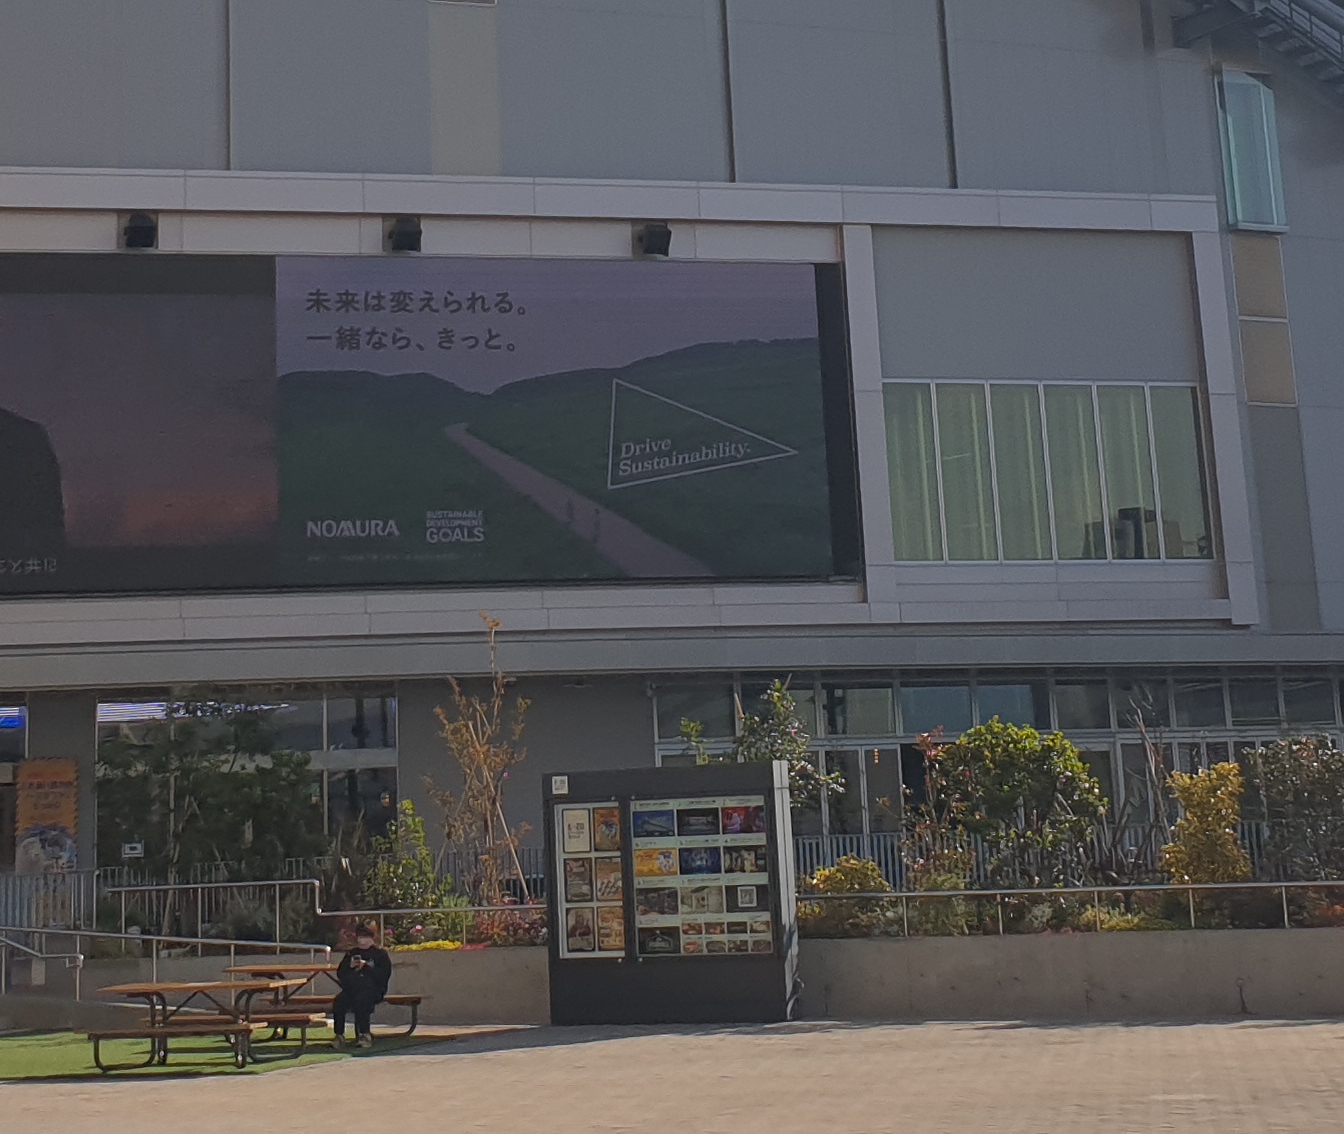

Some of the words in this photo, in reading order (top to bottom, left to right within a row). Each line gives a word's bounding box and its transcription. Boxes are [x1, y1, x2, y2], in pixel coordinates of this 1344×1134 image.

[305, 288, 529, 317] 未来は変えられる。
[305, 325, 517, 352] 一緒なら、きっと。
[619, 438, 672, 459] Drive
[425, 510, 484, 519] SUSTAINABLE
[425, 519, 484, 528] DEVELOPMENT
[306, 519, 400, 538] NOMURA
[425, 527, 485, 543] GOALS
